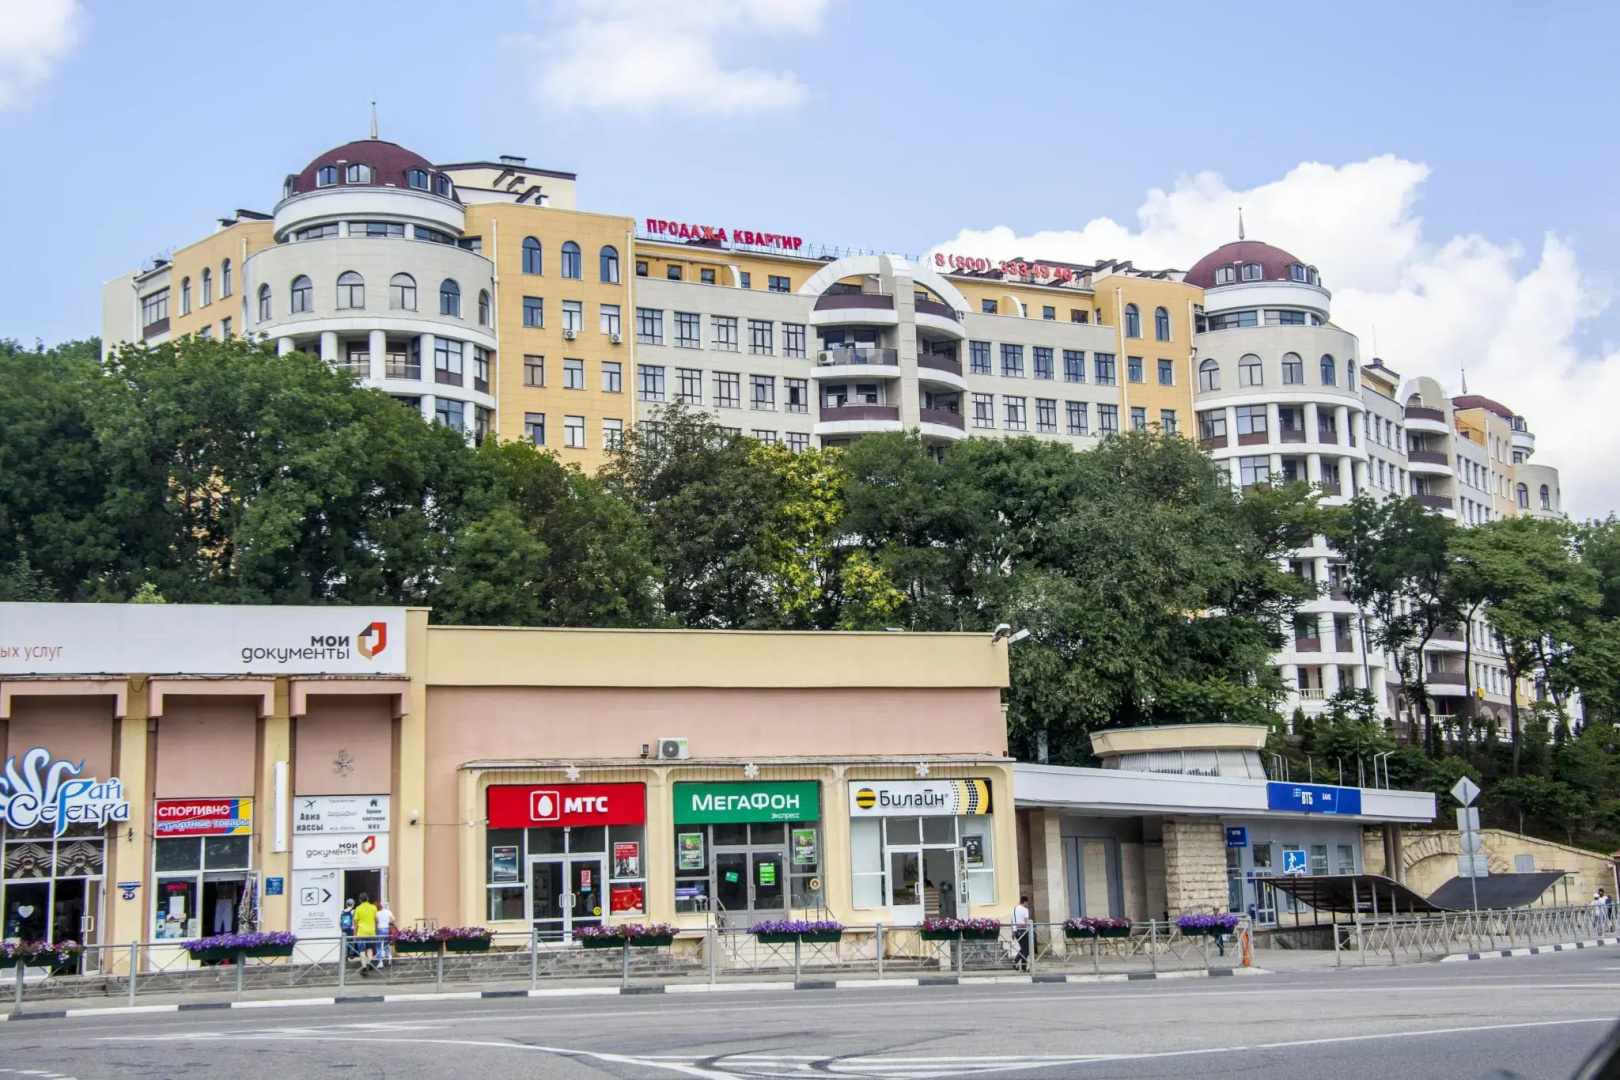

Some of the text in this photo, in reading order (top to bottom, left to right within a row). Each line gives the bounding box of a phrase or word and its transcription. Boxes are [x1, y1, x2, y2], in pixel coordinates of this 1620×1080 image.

[646, 218, 802, 250] ПРОДАЖА КВАРТИР
[934, 253, 945, 267] 8
[948, 253, 992, 271] (800)
[999, 260, 1028, 277] 333
[1053, 266, 1073, 281] 40
[24, 646, 63, 661] услуг
[242, 647, 350, 663] документы
[564, 796, 608, 813] МТС
[1301, 791, 1331, 805] ВТБ БАНК
[158, 805, 230, 817] СПОРТИВНО
[300, 812, 321, 821] Авиа
[213, 818, 250, 828] товары
[296, 823, 324, 832] кассы
[306, 849, 358, 859] документы
